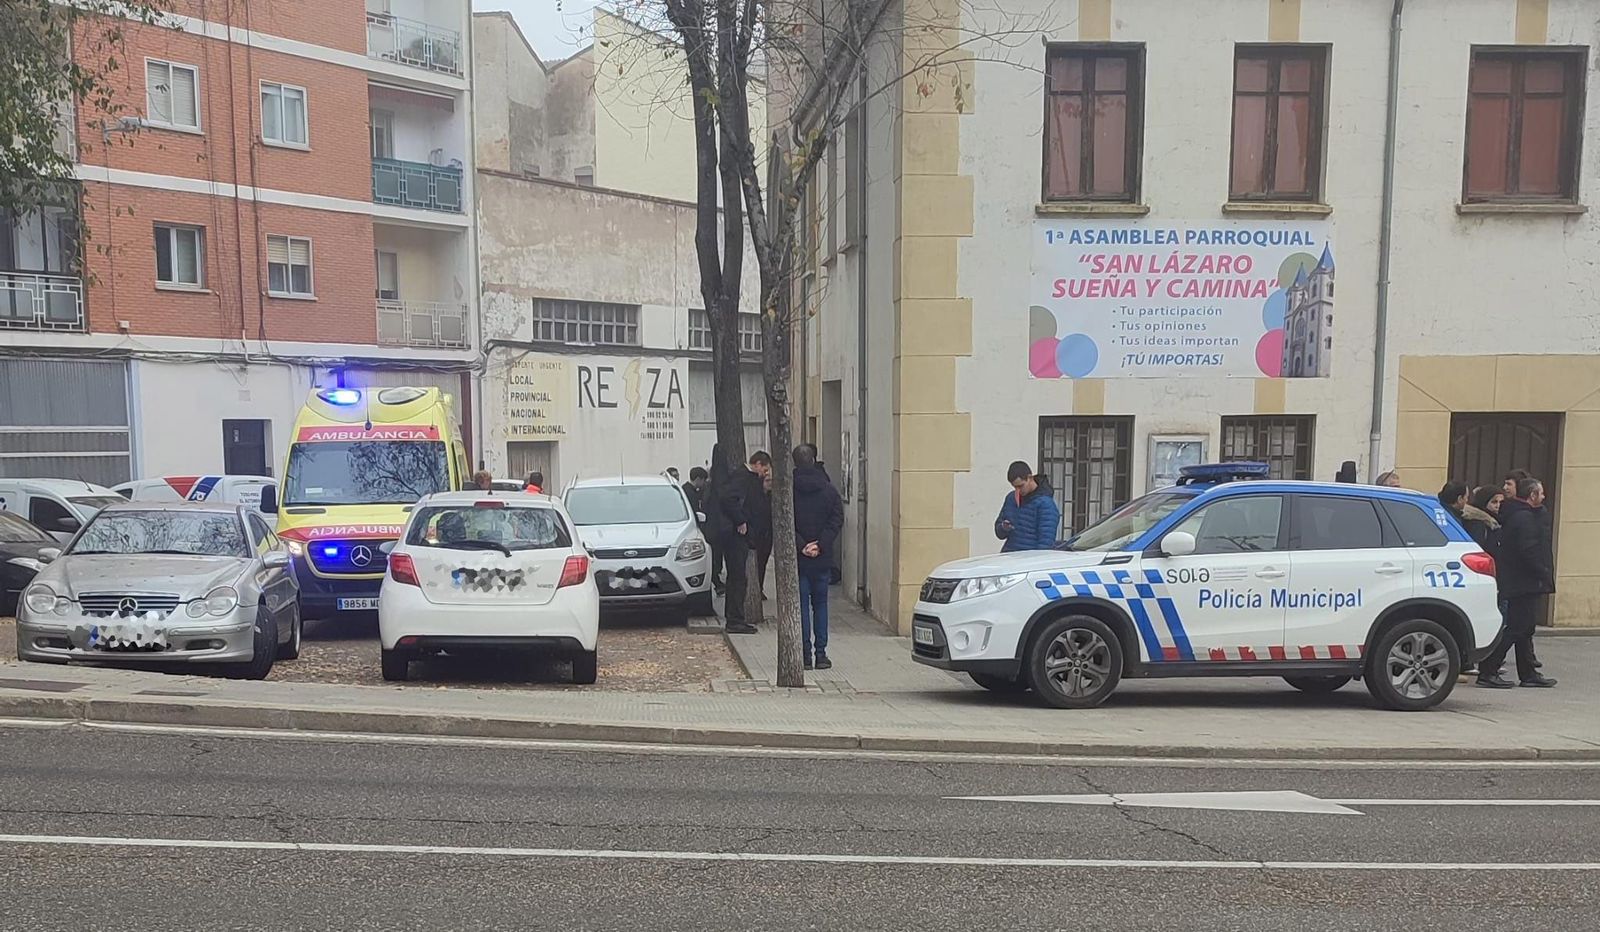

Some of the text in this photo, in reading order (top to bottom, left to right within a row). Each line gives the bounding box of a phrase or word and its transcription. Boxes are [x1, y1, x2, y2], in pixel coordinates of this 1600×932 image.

[1069, 229, 1180, 245] ASAMBLEA
[1185, 229, 1315, 247] PARROQUIAL
[1147, 250, 1253, 274] LÁZARO
[1051, 273, 1137, 298] SUEÑA
[1145, 278, 1161, 298] Y
[1119, 305, 1223, 318] Tu participación
[1119, 320, 1207, 333] Tus opiniones
[1119, 335, 1239, 348] Tus ideas importan
[1121, 352, 1224, 368] ¡TÚ IMPORTAS!
[509, 375, 534, 386] LOCAL
[510, 391, 552, 402] PROVINCIAL
[510, 408, 546, 419] NACIONAL
[309, 431, 428, 441] AMBULANCIA
[511, 424, 567, 435] INTERNACIONAL
[1424, 571, 1466, 588] 112
[1198, 588, 1363, 612] Policía Municipal
